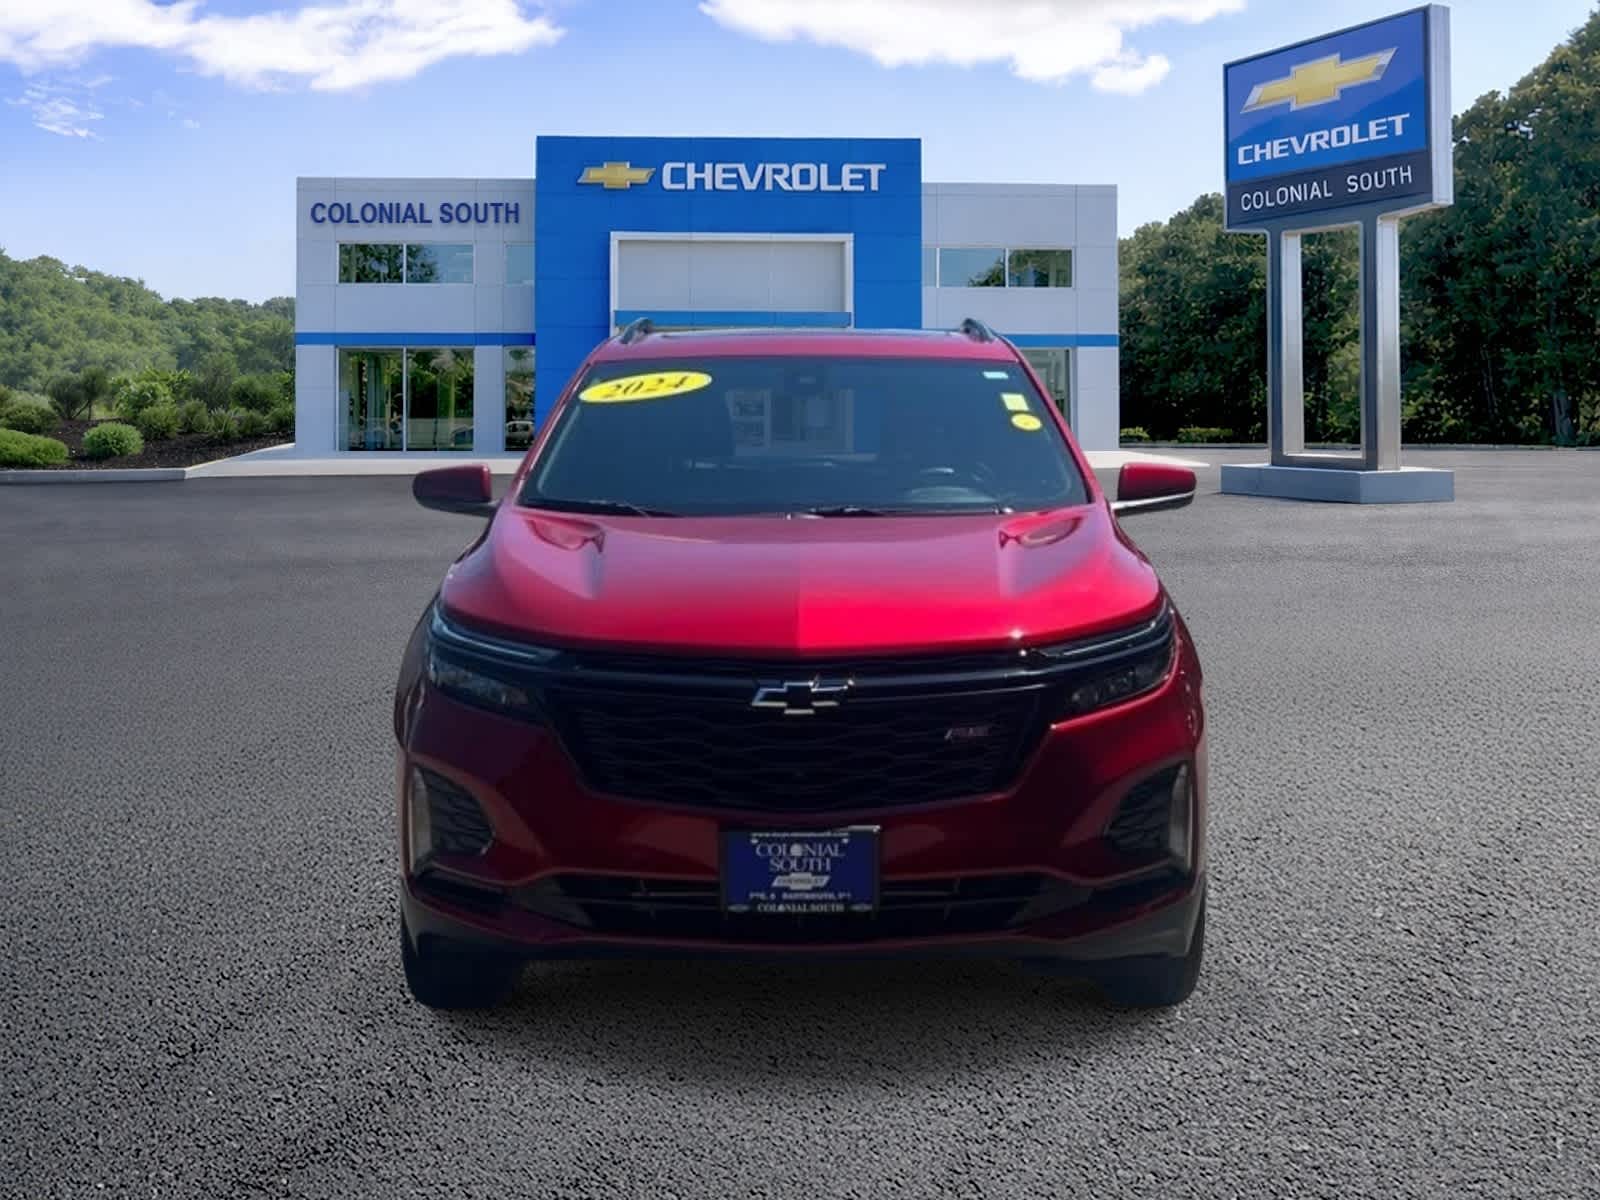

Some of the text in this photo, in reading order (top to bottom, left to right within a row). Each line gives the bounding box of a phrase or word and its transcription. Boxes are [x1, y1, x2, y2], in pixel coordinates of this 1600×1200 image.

[1237, 113, 1410, 165] CHEVROLET
[662, 162, 886, 192] CHEVROLET
[1240, 165, 1413, 211] COLONIAL SOUTH
[310, 202, 520, 225] COLONIAL SOUTH
[602, 373, 690, 399] 2024
[755, 843, 845, 857] COLONIAL
[769, 857, 831, 872] SOUTH
